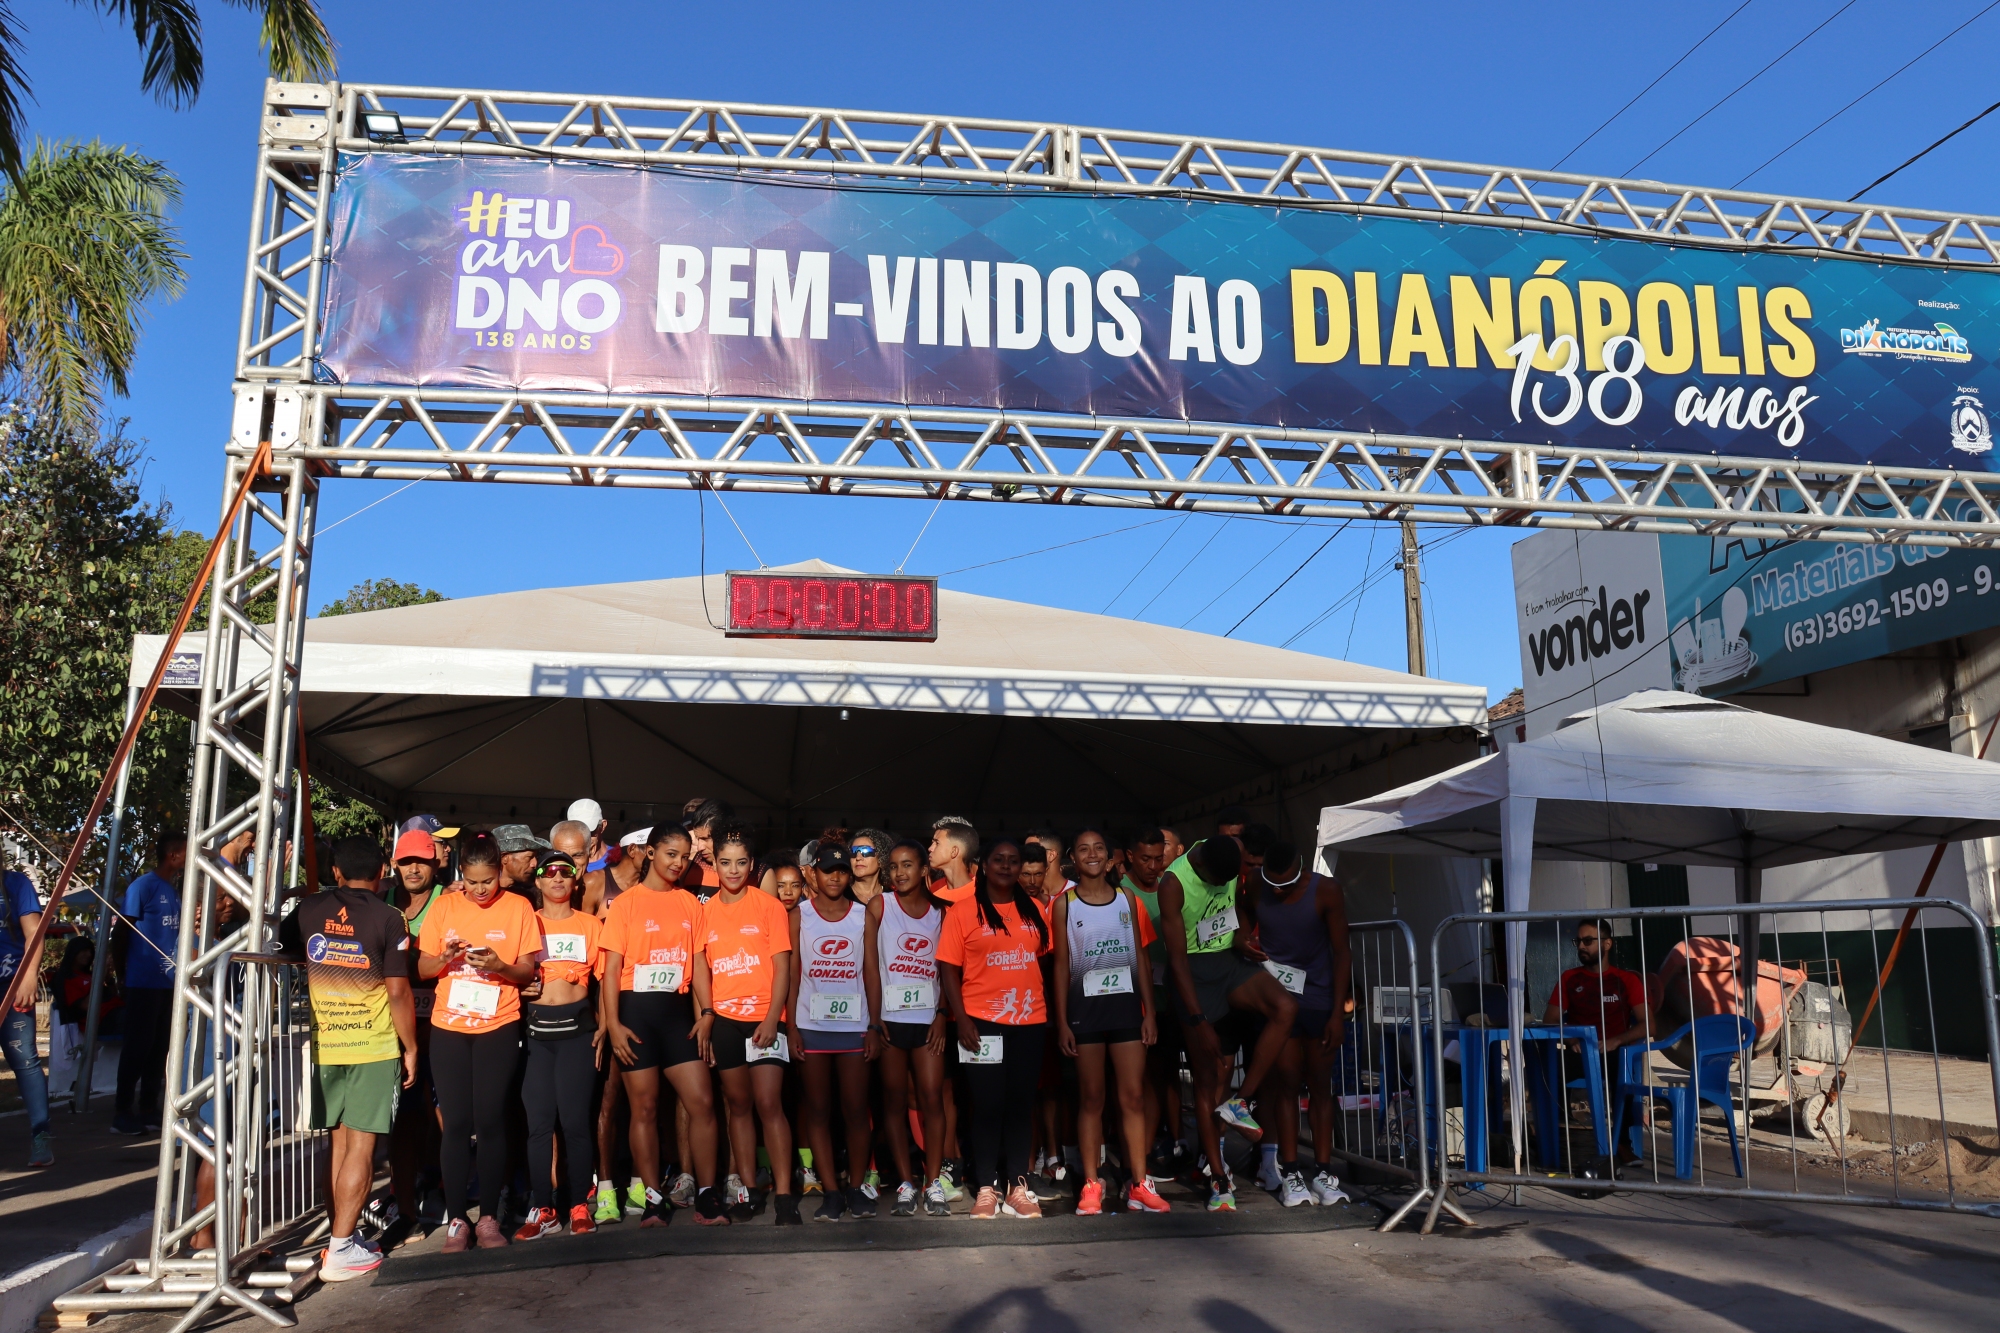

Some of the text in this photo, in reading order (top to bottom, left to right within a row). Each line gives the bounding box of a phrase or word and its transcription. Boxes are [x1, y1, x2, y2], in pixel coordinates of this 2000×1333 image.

[458, 191, 571, 240] #EU
[456, 275, 621, 334] DNO
[655, 243, 1816, 378] BEM-VINDOS AO DIANÓPOLIS
[1918, 299, 1960, 311] Realização:
[475, 331, 592, 351] 138 ANOS
[1504, 332, 1820, 448] 138 anos
[1957, 385, 1980, 394] Apoio:
[1751, 542, 1895, 616] Materiais
[1531, 603, 1545, 616] bom
[1544, 589, 1575, 609] trabalhar
[1574, 585, 1590, 597] com
[1784, 577, 1950, 652] (63)3692-1509
[1528, 585, 1650, 677] vonder
[324, 922, 355, 934] STRAVA
[1211, 916, 1227, 931] 62
[555, 941, 574, 954] 34
[819, 939, 850, 956] GP
[903, 937, 929, 954] GP
[1096, 938, 1120, 949] CMTO
[894, 955, 913, 963] AUTO
[1084, 946, 1106, 958] JOCA
[650, 971, 676, 985] 107
[1101, 974, 1119, 987] 42
[1277, 969, 1294, 984] 75
[903, 990, 920, 1003] 81
[829, 1000, 849, 1014] 80
